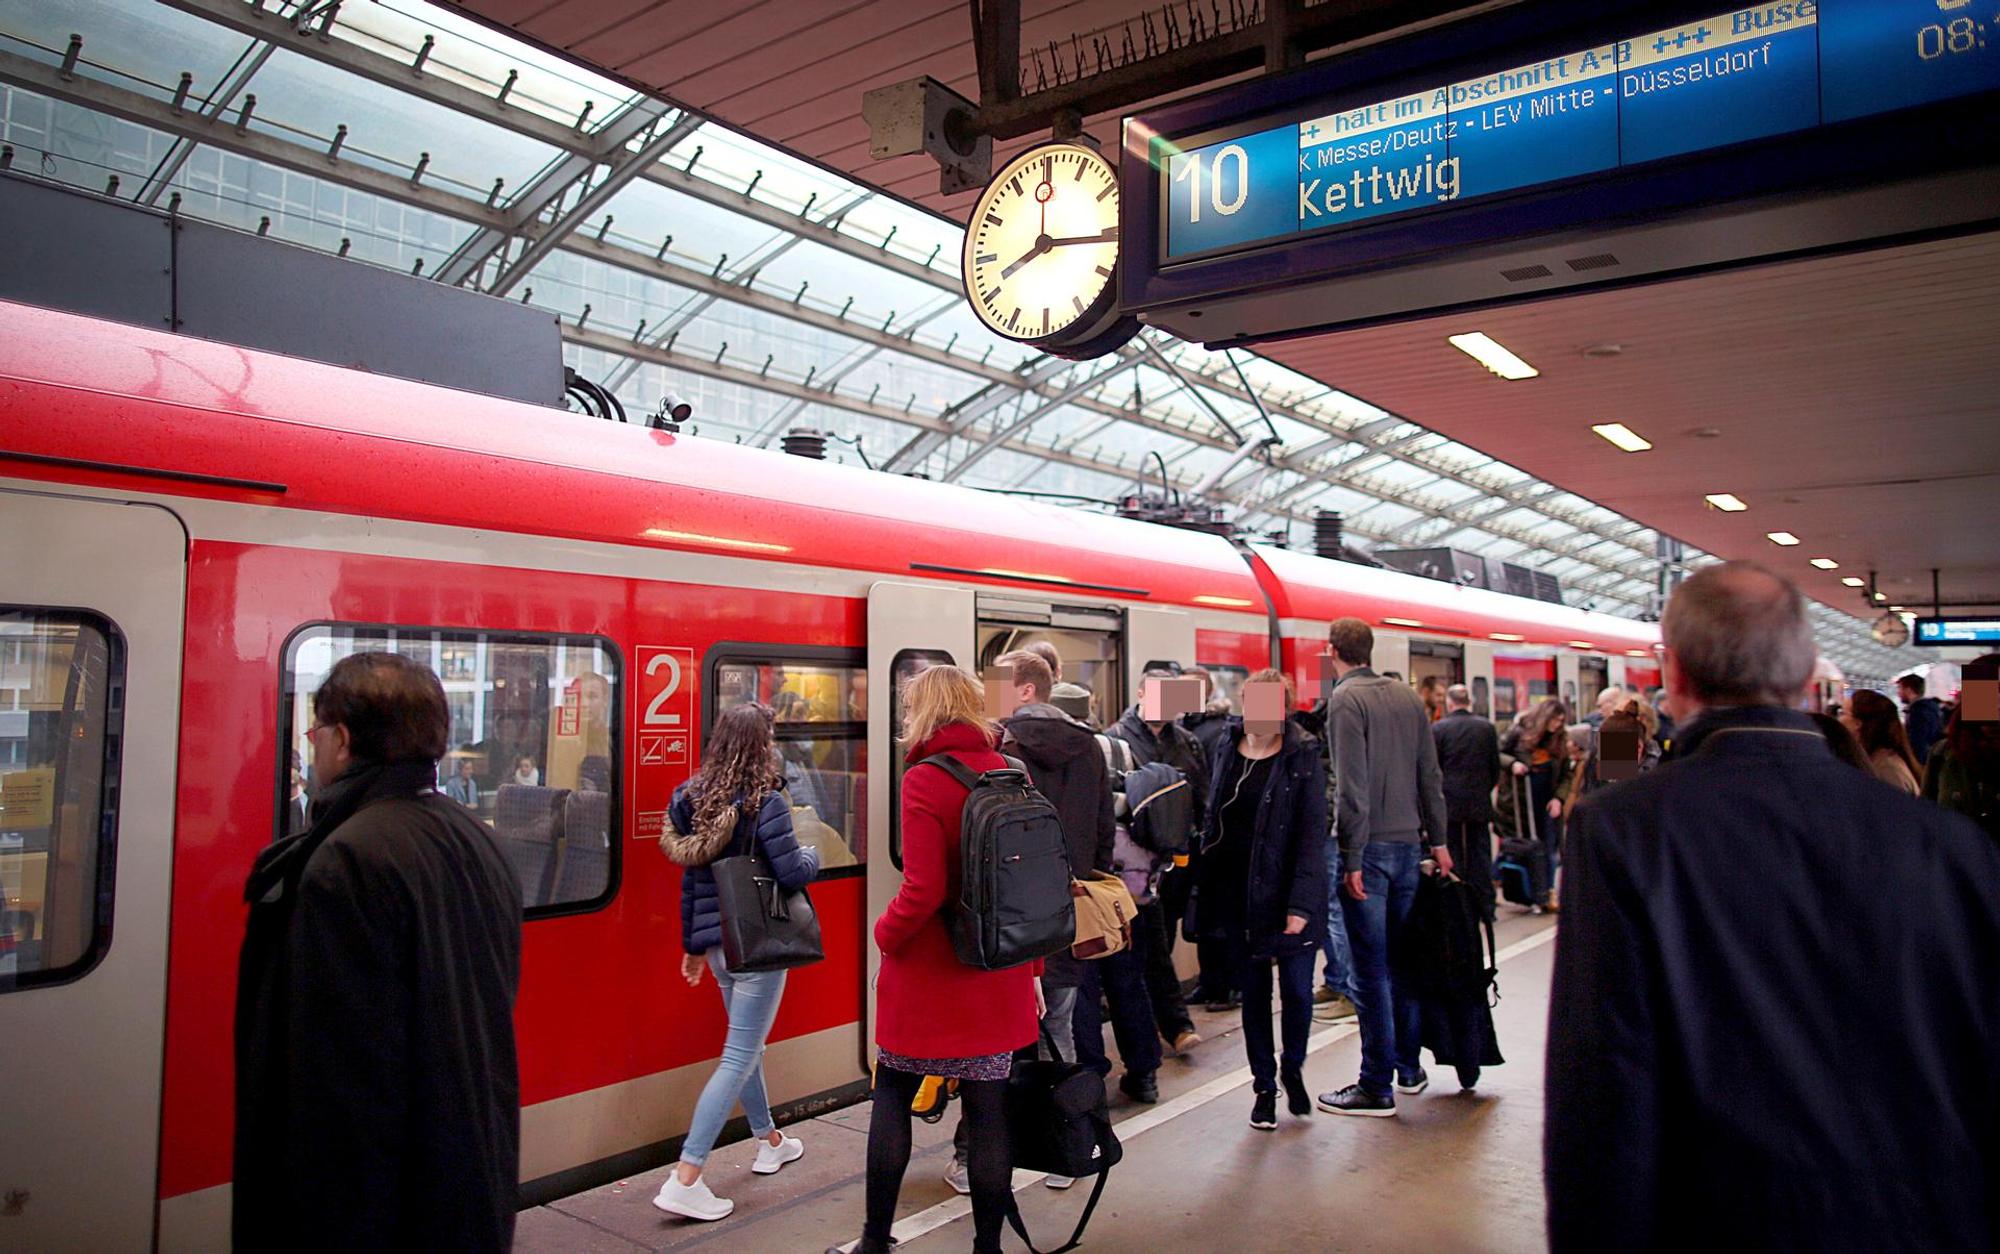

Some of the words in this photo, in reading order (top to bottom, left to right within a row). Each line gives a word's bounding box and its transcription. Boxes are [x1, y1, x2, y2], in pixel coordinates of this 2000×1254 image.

[1300, 152, 1312, 173] K
[1318, 121, 1458, 169] Messe/Deutz
[1482, 102, 1523, 131] LEV
[1531, 88, 1595, 120] Mitte
[1623, 41, 1772, 98] Düsseldorf
[1335, 109, 1387, 134] hält
[1394, 97, 1423, 119] im
[1432, 58, 1570, 110] Abschnitt
[1579, 41, 1633, 74] A-B
[1652, 26, 1712, 55] +++
[1175, 143, 1249, 224] 10
[1299, 153, 1461, 220] Kettwig
[644, 653, 682, 725] 2
